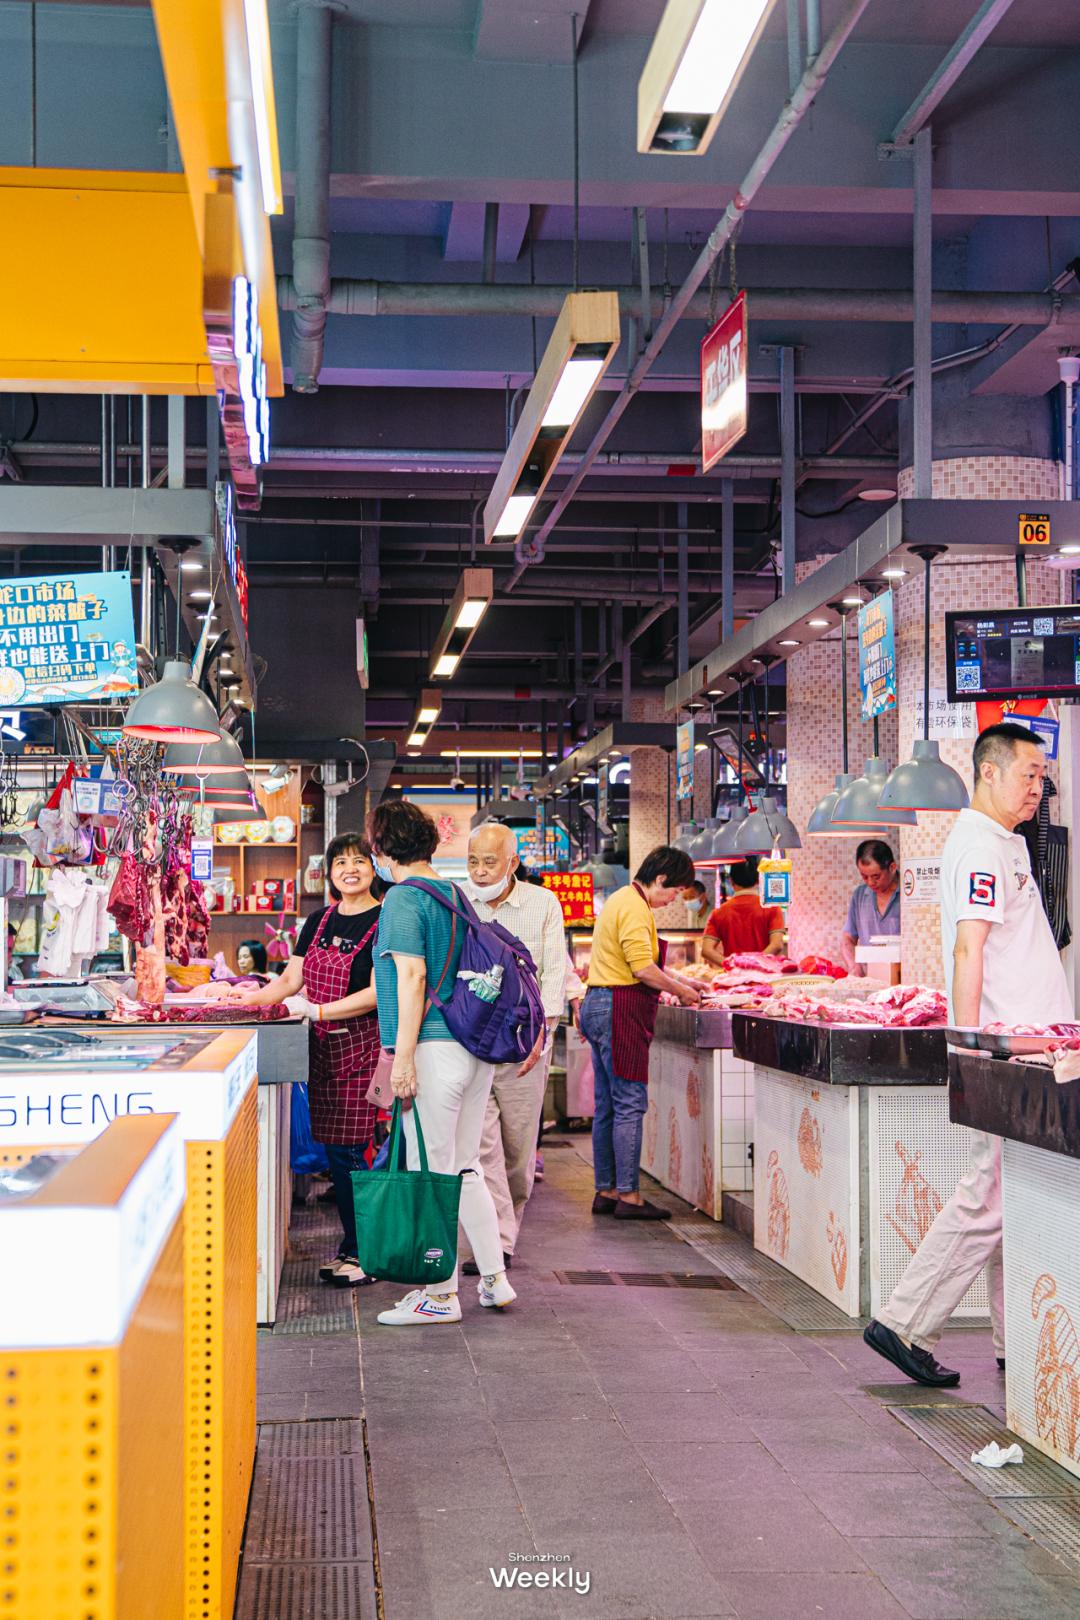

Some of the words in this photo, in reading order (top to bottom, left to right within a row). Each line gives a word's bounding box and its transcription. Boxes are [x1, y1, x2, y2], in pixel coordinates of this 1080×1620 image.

[1023, 523, 1047, 542] 06
[0, 600, 107, 625] 边的菜篮子
